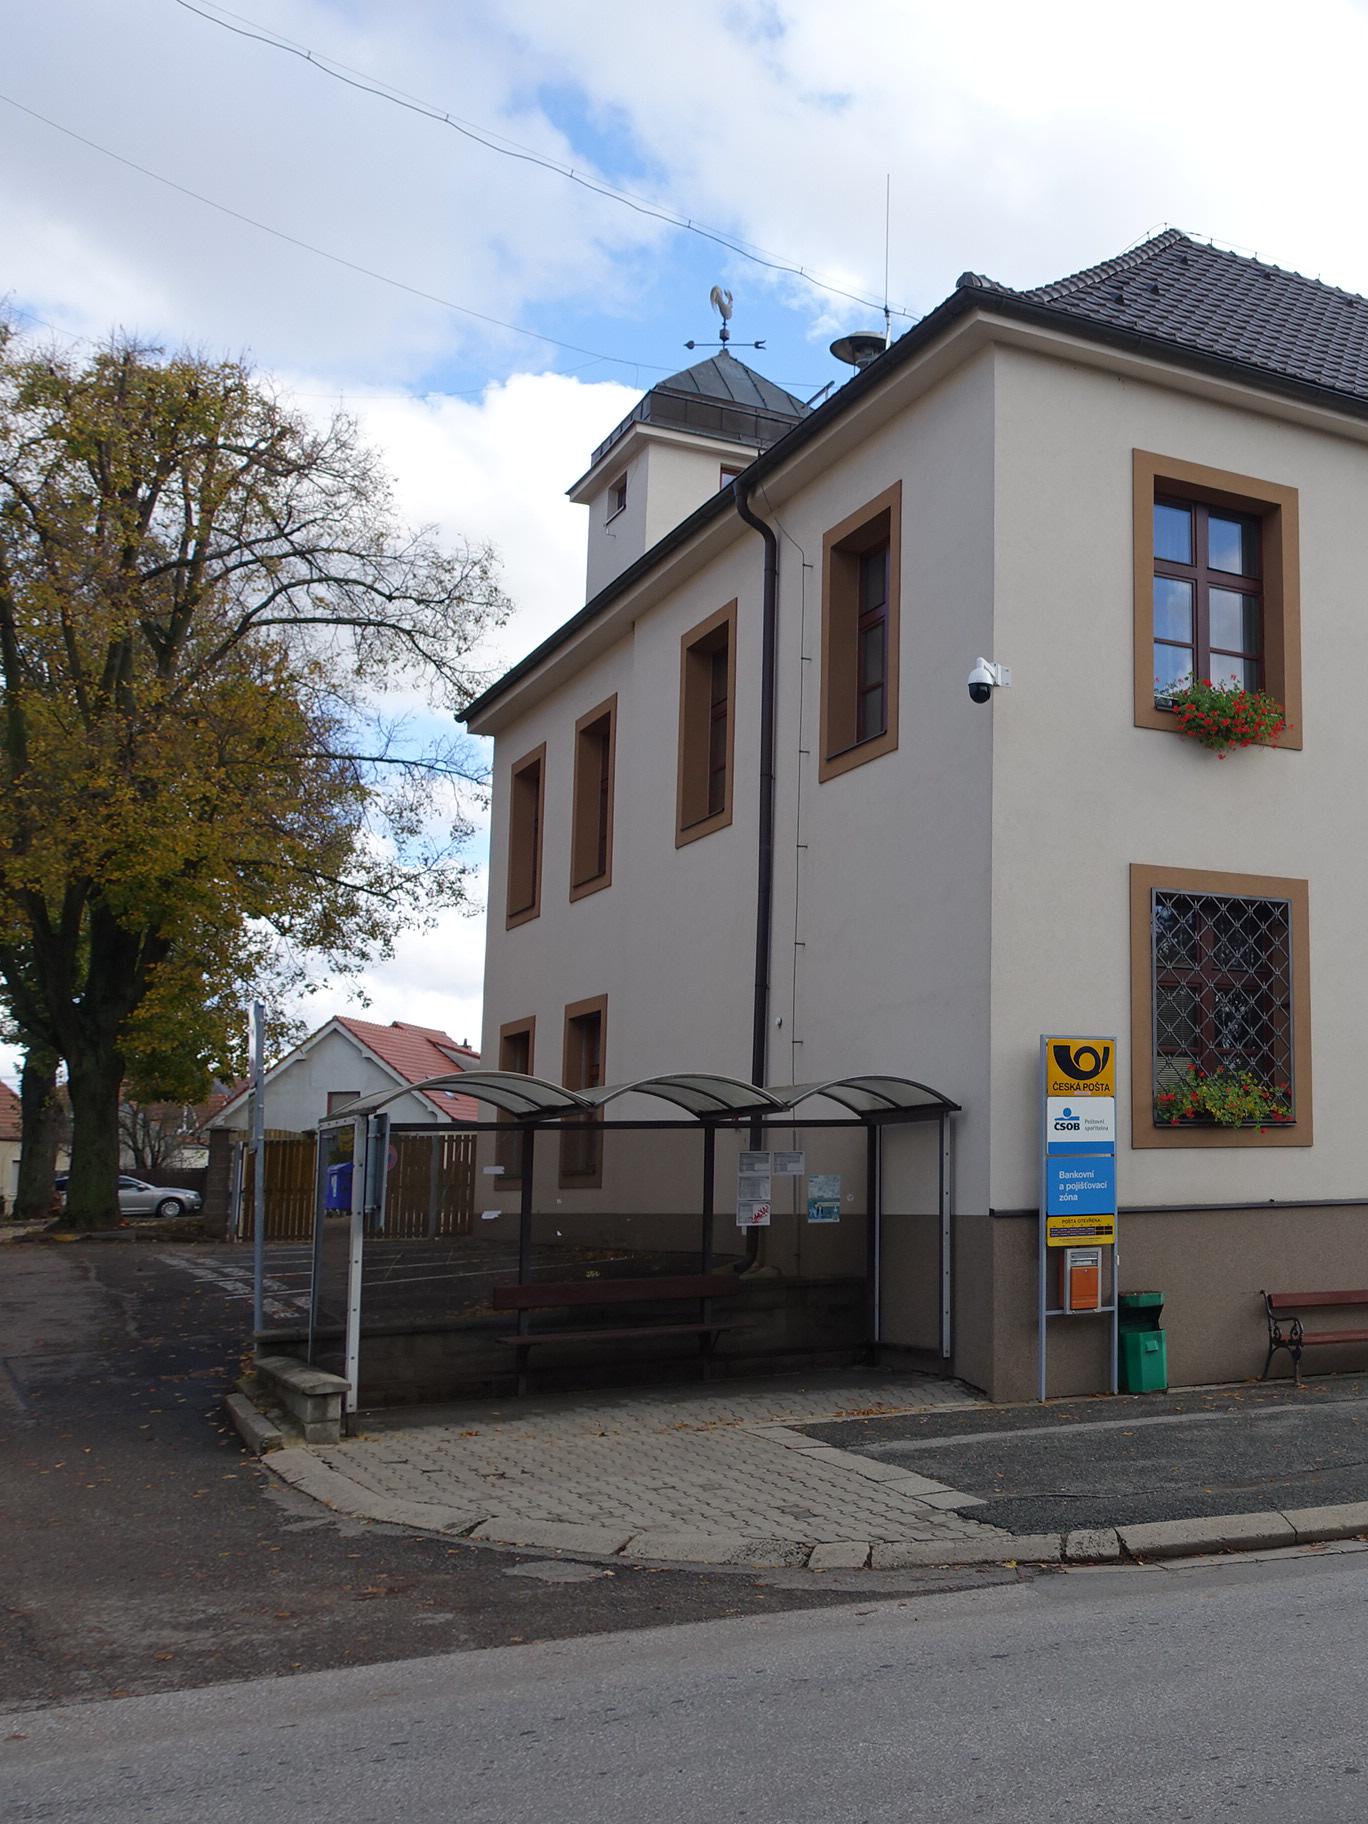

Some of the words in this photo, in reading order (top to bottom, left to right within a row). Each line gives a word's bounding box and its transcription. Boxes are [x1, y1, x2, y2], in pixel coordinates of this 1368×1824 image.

[1052, 1081, 1081, 1091] ČESKÁ
[1083, 1081, 1110, 1091] POŠTA
[1054, 1122, 1080, 1131] ČSOB
[1059, 1170, 1094, 1179] Bankovní
[1066, 1181, 1107, 1191] pojišťovací
[1059, 1193, 1079, 1201] zóna
